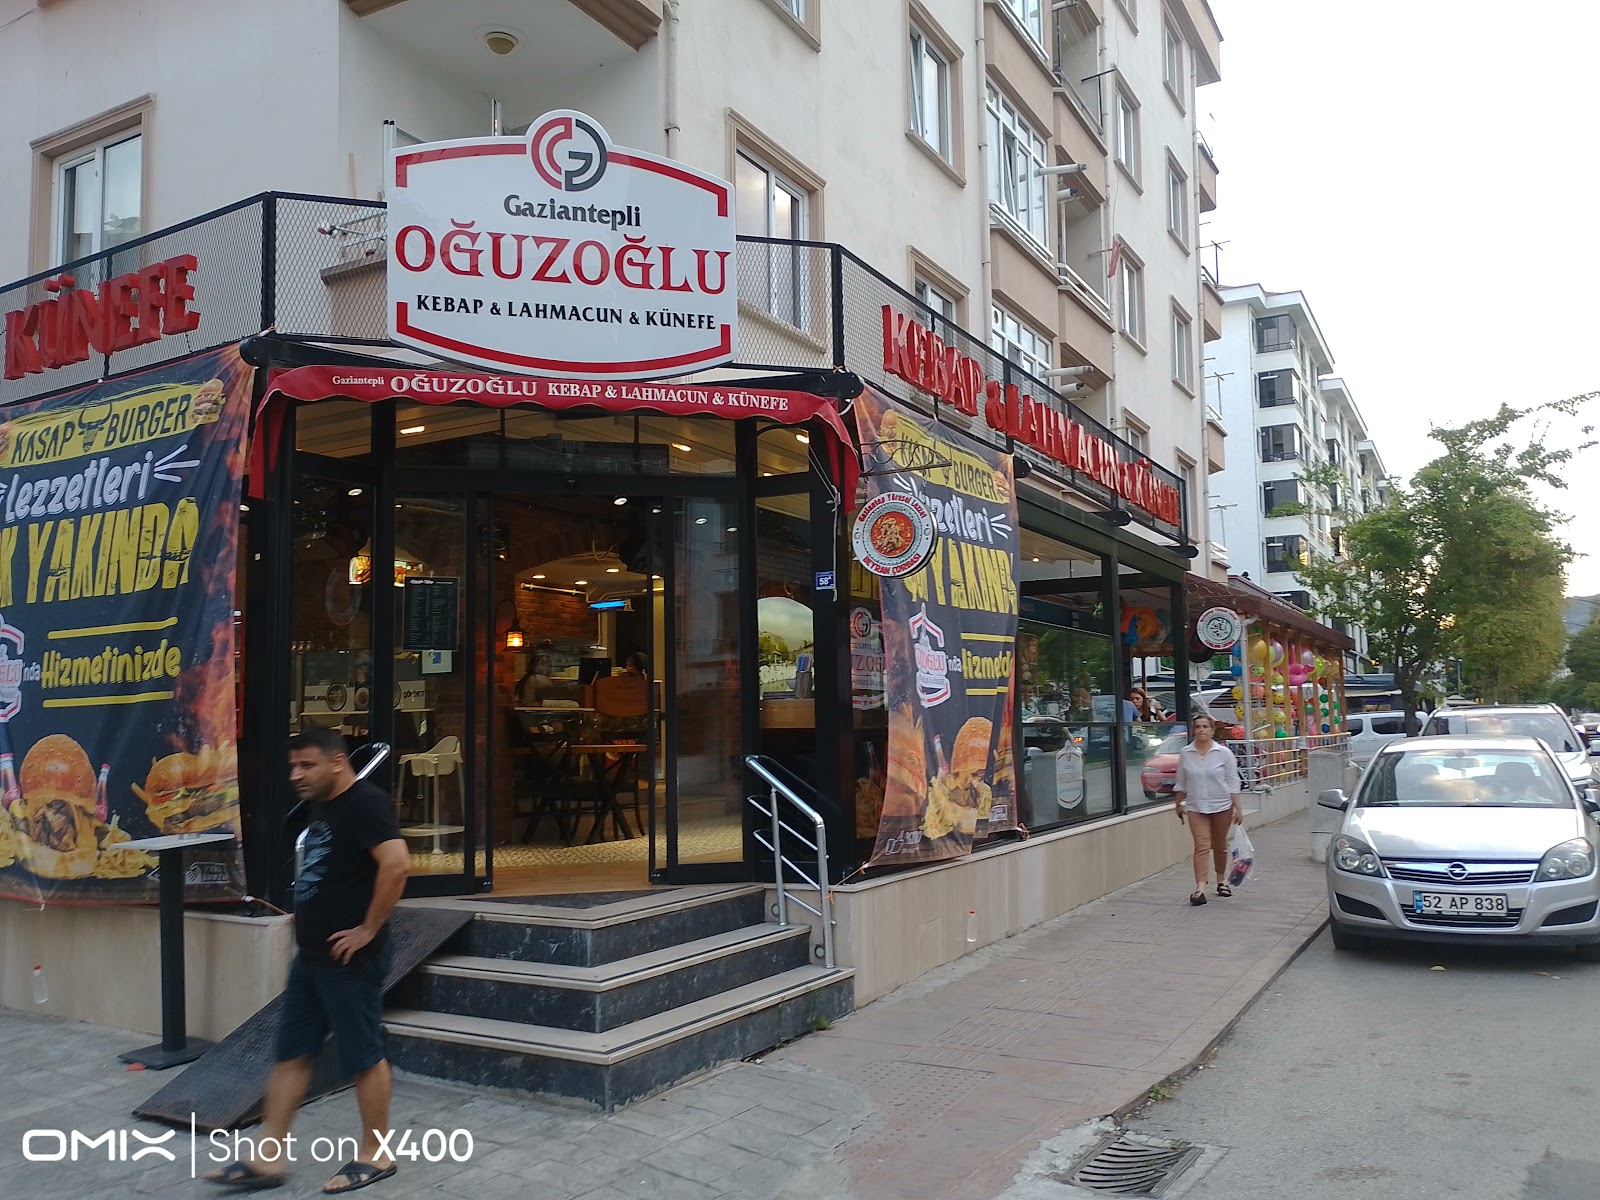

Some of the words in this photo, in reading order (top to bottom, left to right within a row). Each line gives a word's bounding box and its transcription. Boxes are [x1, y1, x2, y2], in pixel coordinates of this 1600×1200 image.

[504, 194, 641, 231] Gaziantepli
[395, 218, 732, 294] OĞUZOĞLU
[4, 254, 200, 380] KÜNEFE
[416, 294, 483, 315] KEBAP
[490, 302, 501, 316] &
[508, 301, 623, 324] LAHMACUN
[629, 311, 640, 325] &
[646, 308, 716, 330] KÜNEFE
[332, 375, 385, 387] Gaziantepli
[390, 373, 538, 396] OĞUZOĞLU
[547, 382, 602, 398] KEBAP
[605, 388, 617, 399] &
[621, 387, 708, 404] LAHMACUN
[712, 392, 724, 405] &
[728, 391, 788, 411] KÜNEFE
[881, 304, 983, 417] KEBAP
[1005, 383, 1121, 495] LAHMACUN
[11, 421, 76, 464] KASAP
[104, 393, 192, 447] BURGER
[5, 450, 154, 524] lezzetleri
[953, 460, 999, 502] BURGER
[26, 496, 199, 604] YAKINDA
[41, 638, 182, 689] Hizmetinizde
[1423, 895, 1442, 909] 52
[1449, 896, 1468, 910] AP
[1475, 897, 1504, 911] 838
